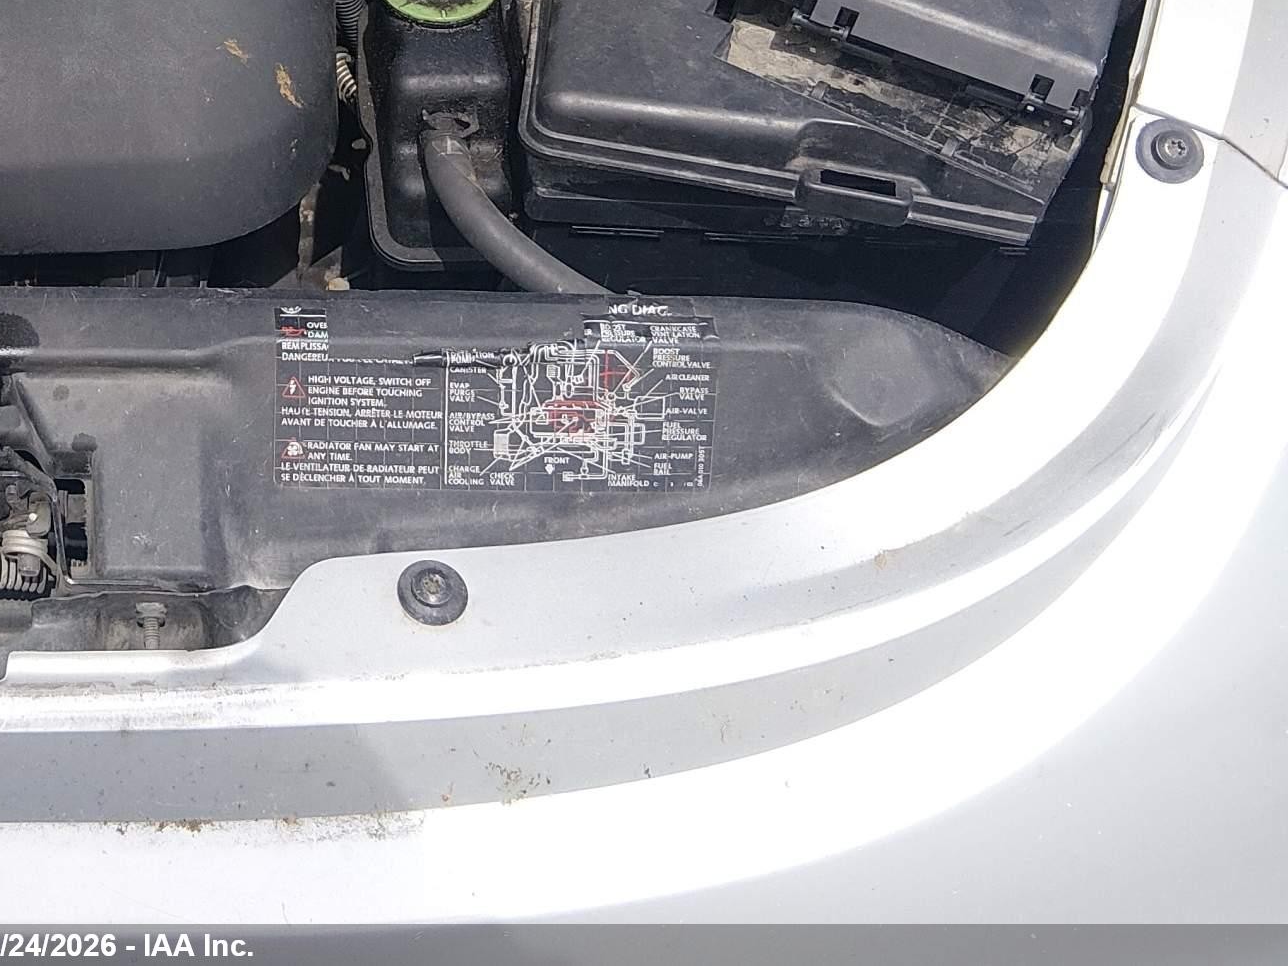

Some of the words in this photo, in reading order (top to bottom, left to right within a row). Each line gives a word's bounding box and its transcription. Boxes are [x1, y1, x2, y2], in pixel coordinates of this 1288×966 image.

[281, 341, 329, 351] REMPLISSA
[308, 375, 331, 384] HIGH
[378, 377, 412, 386] SWITCH
[414, 378, 432, 386] OFF
[308, 386, 340, 395] ENGINE
[342, 387, 374, 395] BEFORE
[376, 388, 423, 397] TOUCHING
[308, 397, 348, 406] IGNITION
[393, 409, 403, 418] LE
[405, 410, 443, 419] MOTEUR
[281, 418, 312, 426] AVANT
[314, 418, 325, 427] DE
[328, 419, 368, 428] TOUCHER
[307, 441, 352, 450] RADIATOR
[353, 442, 372, 451] FAN
[374, 443, 396, 452] MAY
[398, 444, 425, 452] START
[427, 444, 439, 452] AT
[448, 440, 488, 448] THROTTLE
[307, 452, 326, 461] ANY
[544, 456, 570, 464] FRONT
[281, 463, 290, 471] LE
[292, 463, 351, 472] VENTILATEUR
[353, 464, 364, 473] DE
[366, 465, 415, 474] RADIATEUR
[418, 465, 440, 474] PEUT
[280, 473, 291, 481] SE
[357, 475, 380, 483] TOUT
[490, 478, 515, 486] VALVE
